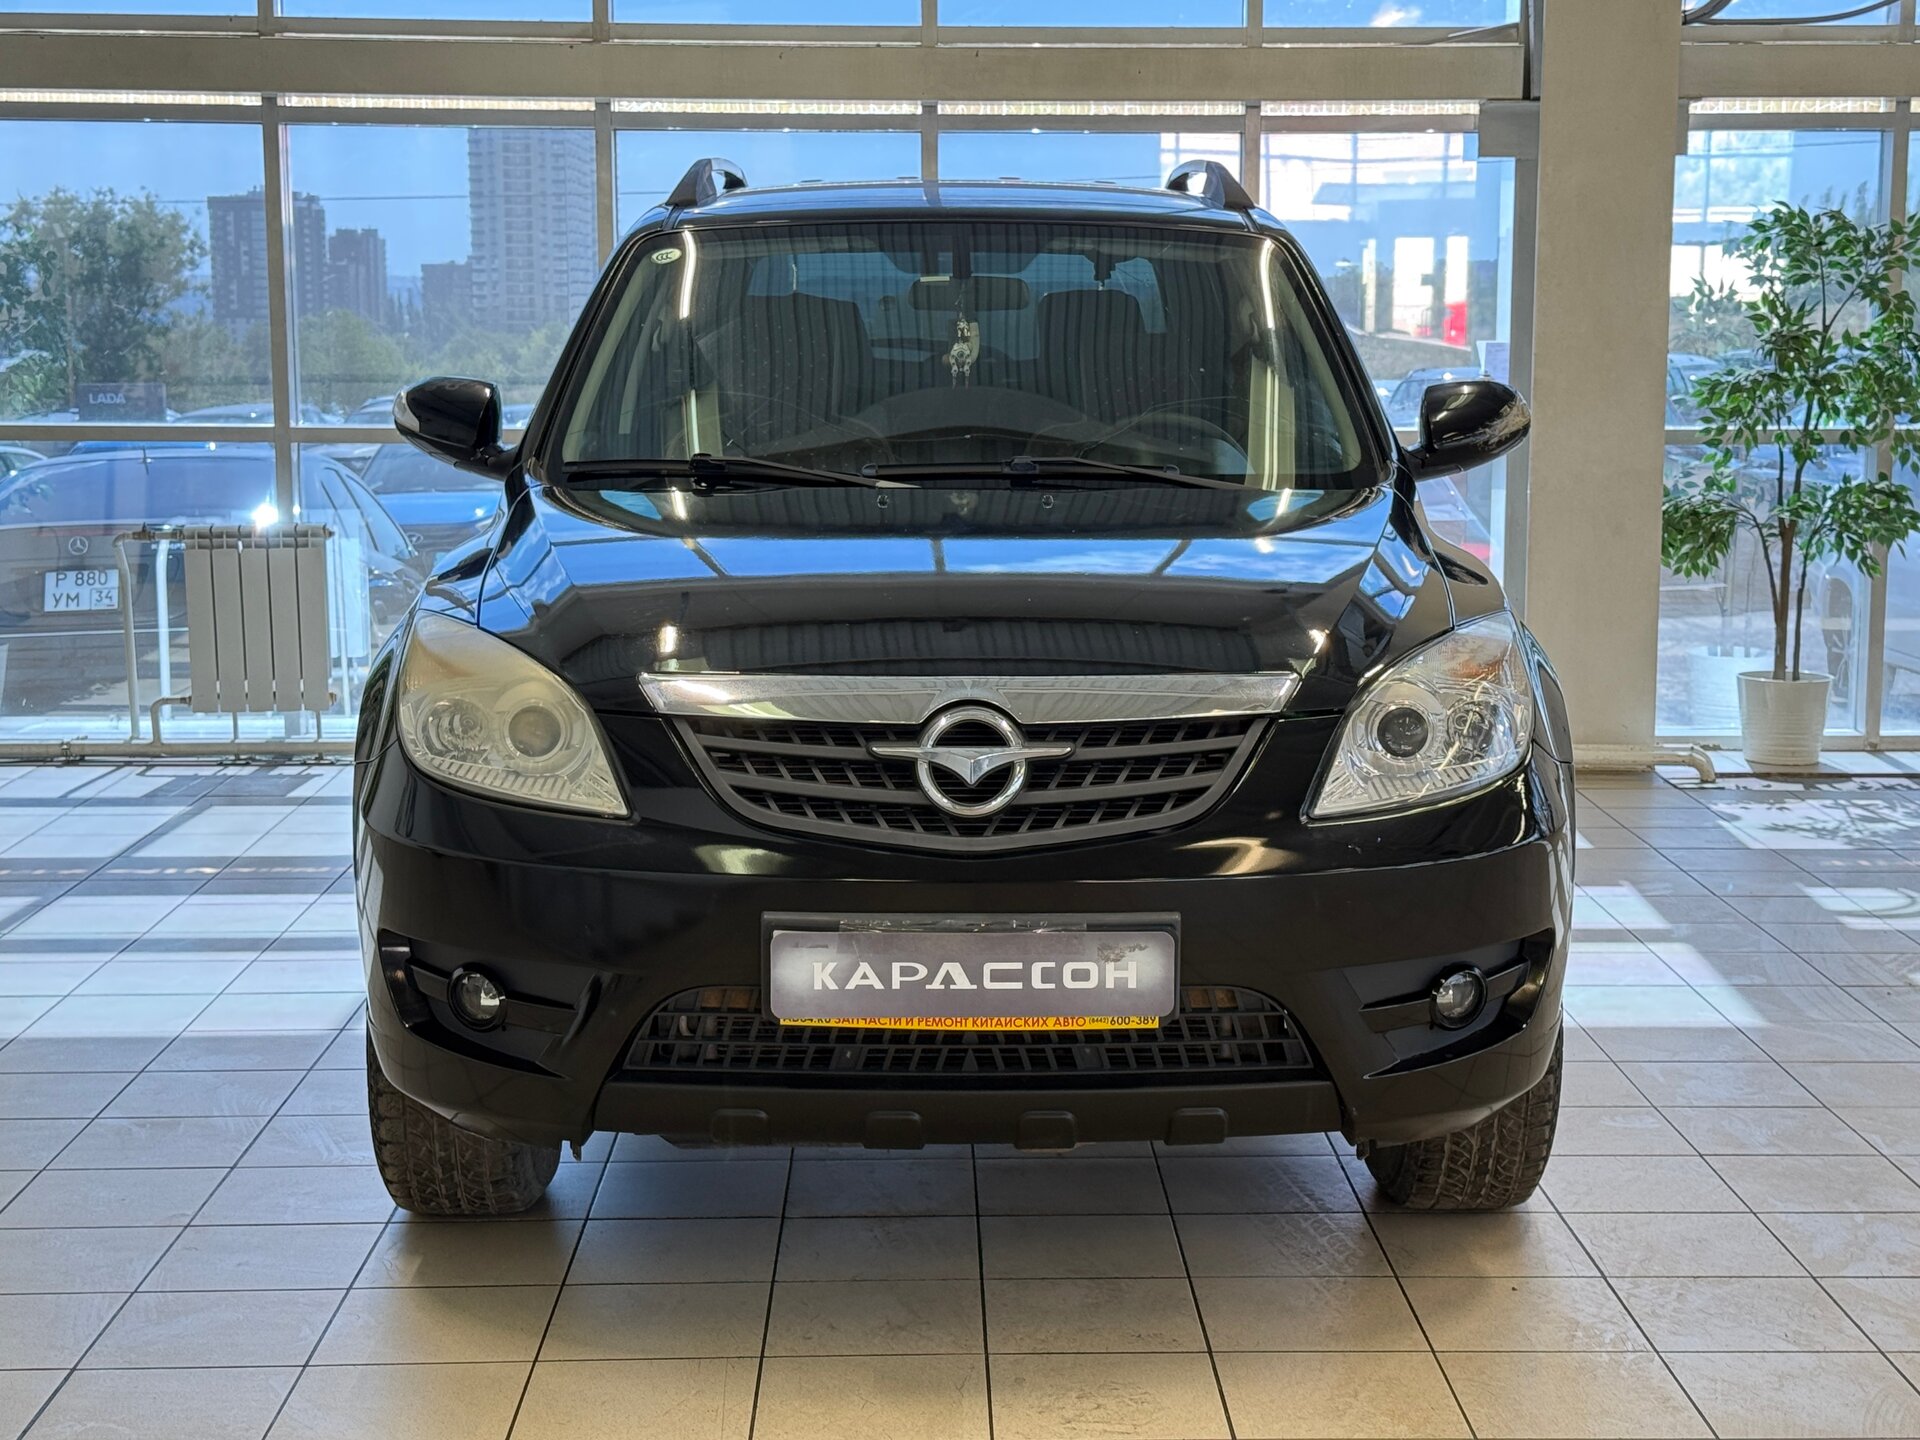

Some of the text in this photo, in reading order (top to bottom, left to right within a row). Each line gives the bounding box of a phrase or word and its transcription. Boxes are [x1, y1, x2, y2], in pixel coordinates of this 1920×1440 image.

[89, 392, 126, 404] LADA
[75, 570, 108, 587] 880
[53, 590, 113, 608] УМ 34
[905, 1017, 914, 1027] И
[917, 1017, 969, 1028] РЕМОНТ
[1053, 1016, 1087, 1028] АВТО
